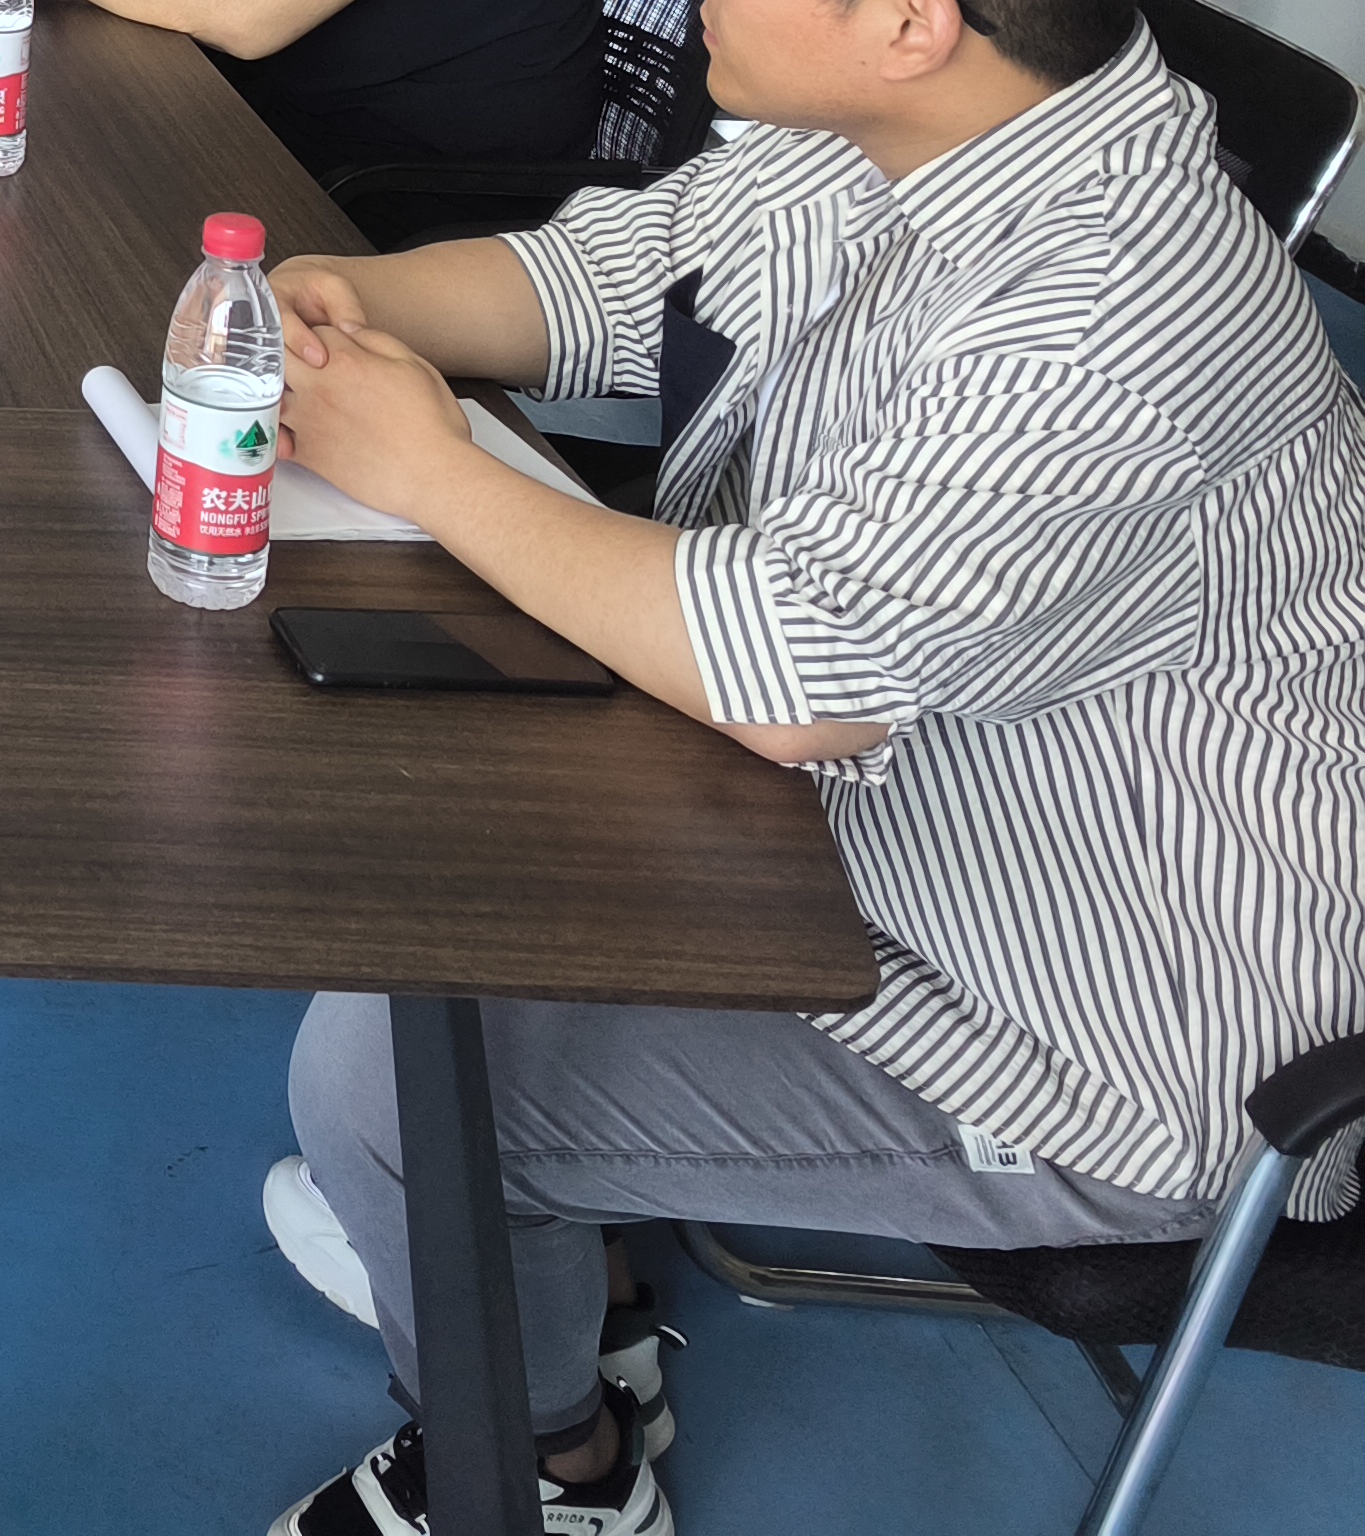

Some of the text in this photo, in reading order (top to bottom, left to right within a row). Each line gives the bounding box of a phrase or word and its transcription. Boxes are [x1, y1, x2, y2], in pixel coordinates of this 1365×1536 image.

[201, 482, 272, 511] 农夫山
[200, 510, 248, 526] NONGFU
